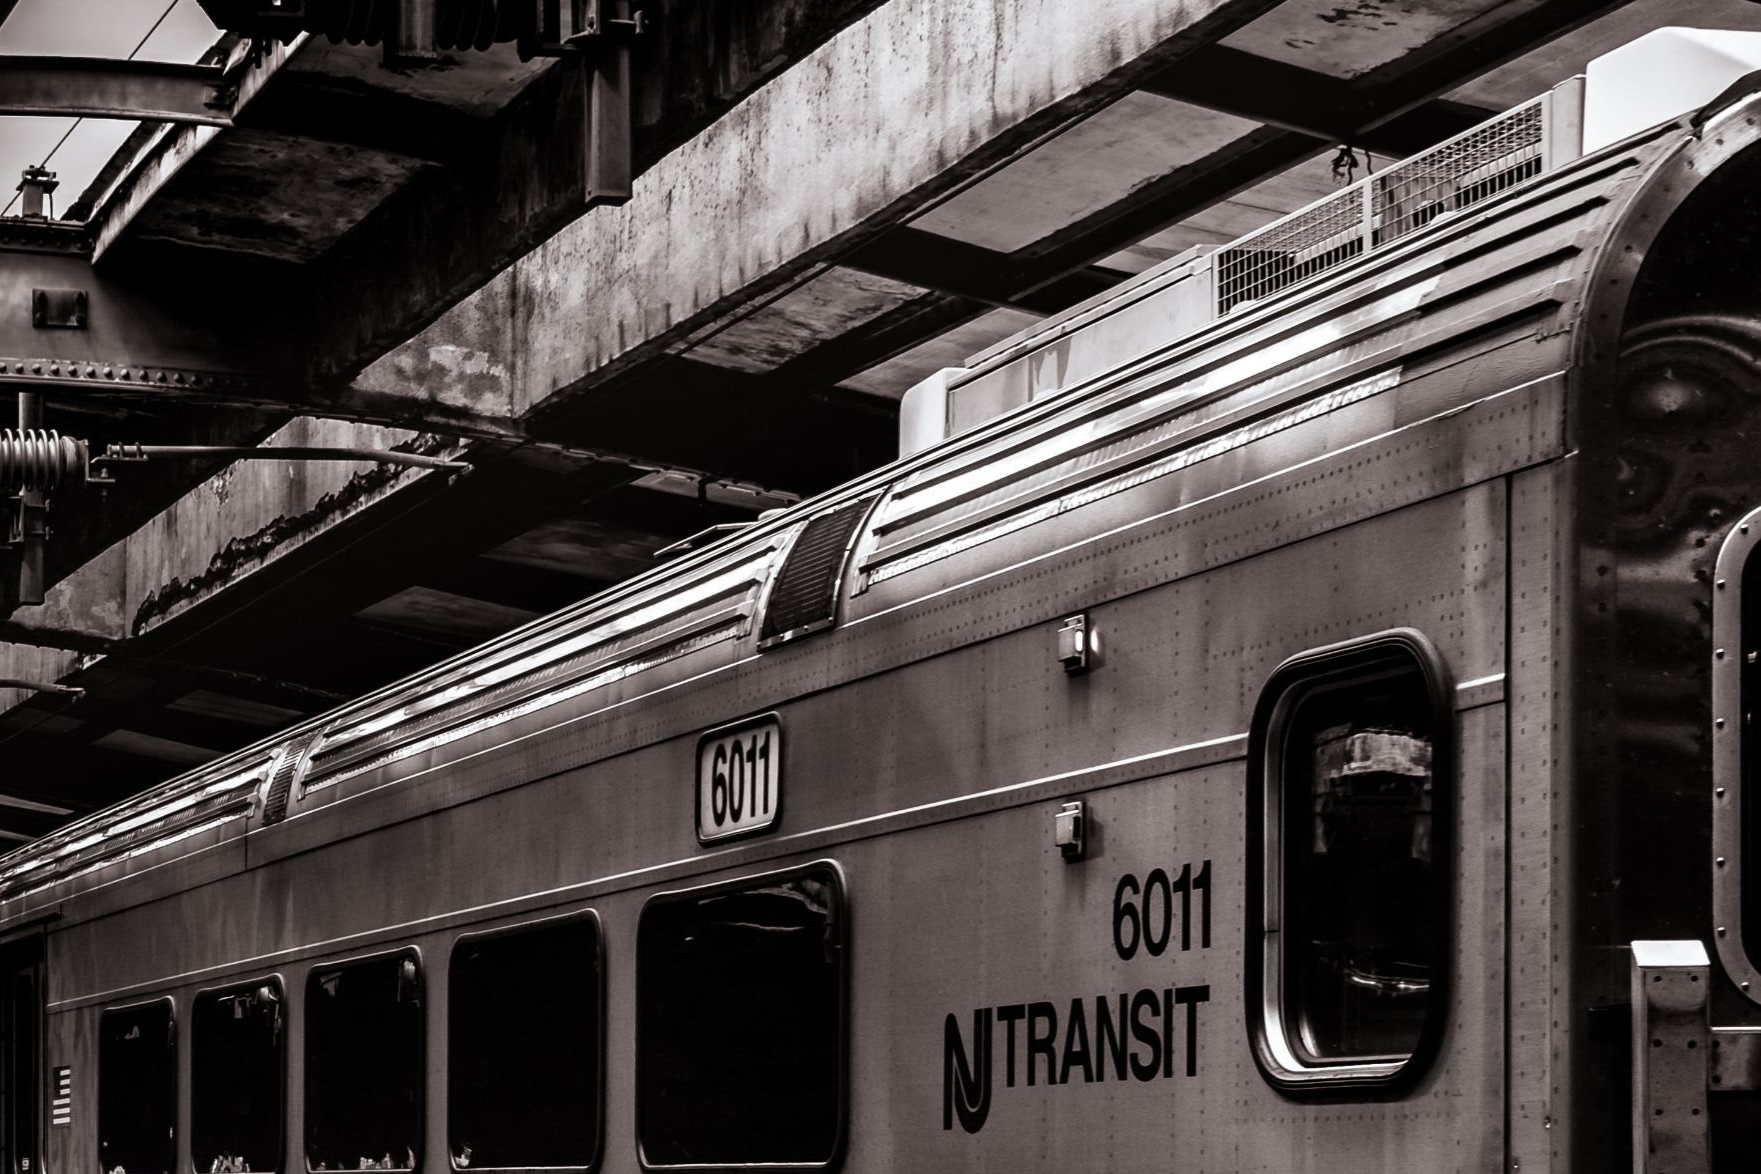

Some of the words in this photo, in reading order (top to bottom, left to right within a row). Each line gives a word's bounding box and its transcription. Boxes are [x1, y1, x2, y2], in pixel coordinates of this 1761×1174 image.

[712, 731, 770, 827] 6011
[1113, 859, 1211, 961] 6011
[997, 985, 1210, 1087] TRANSIT
